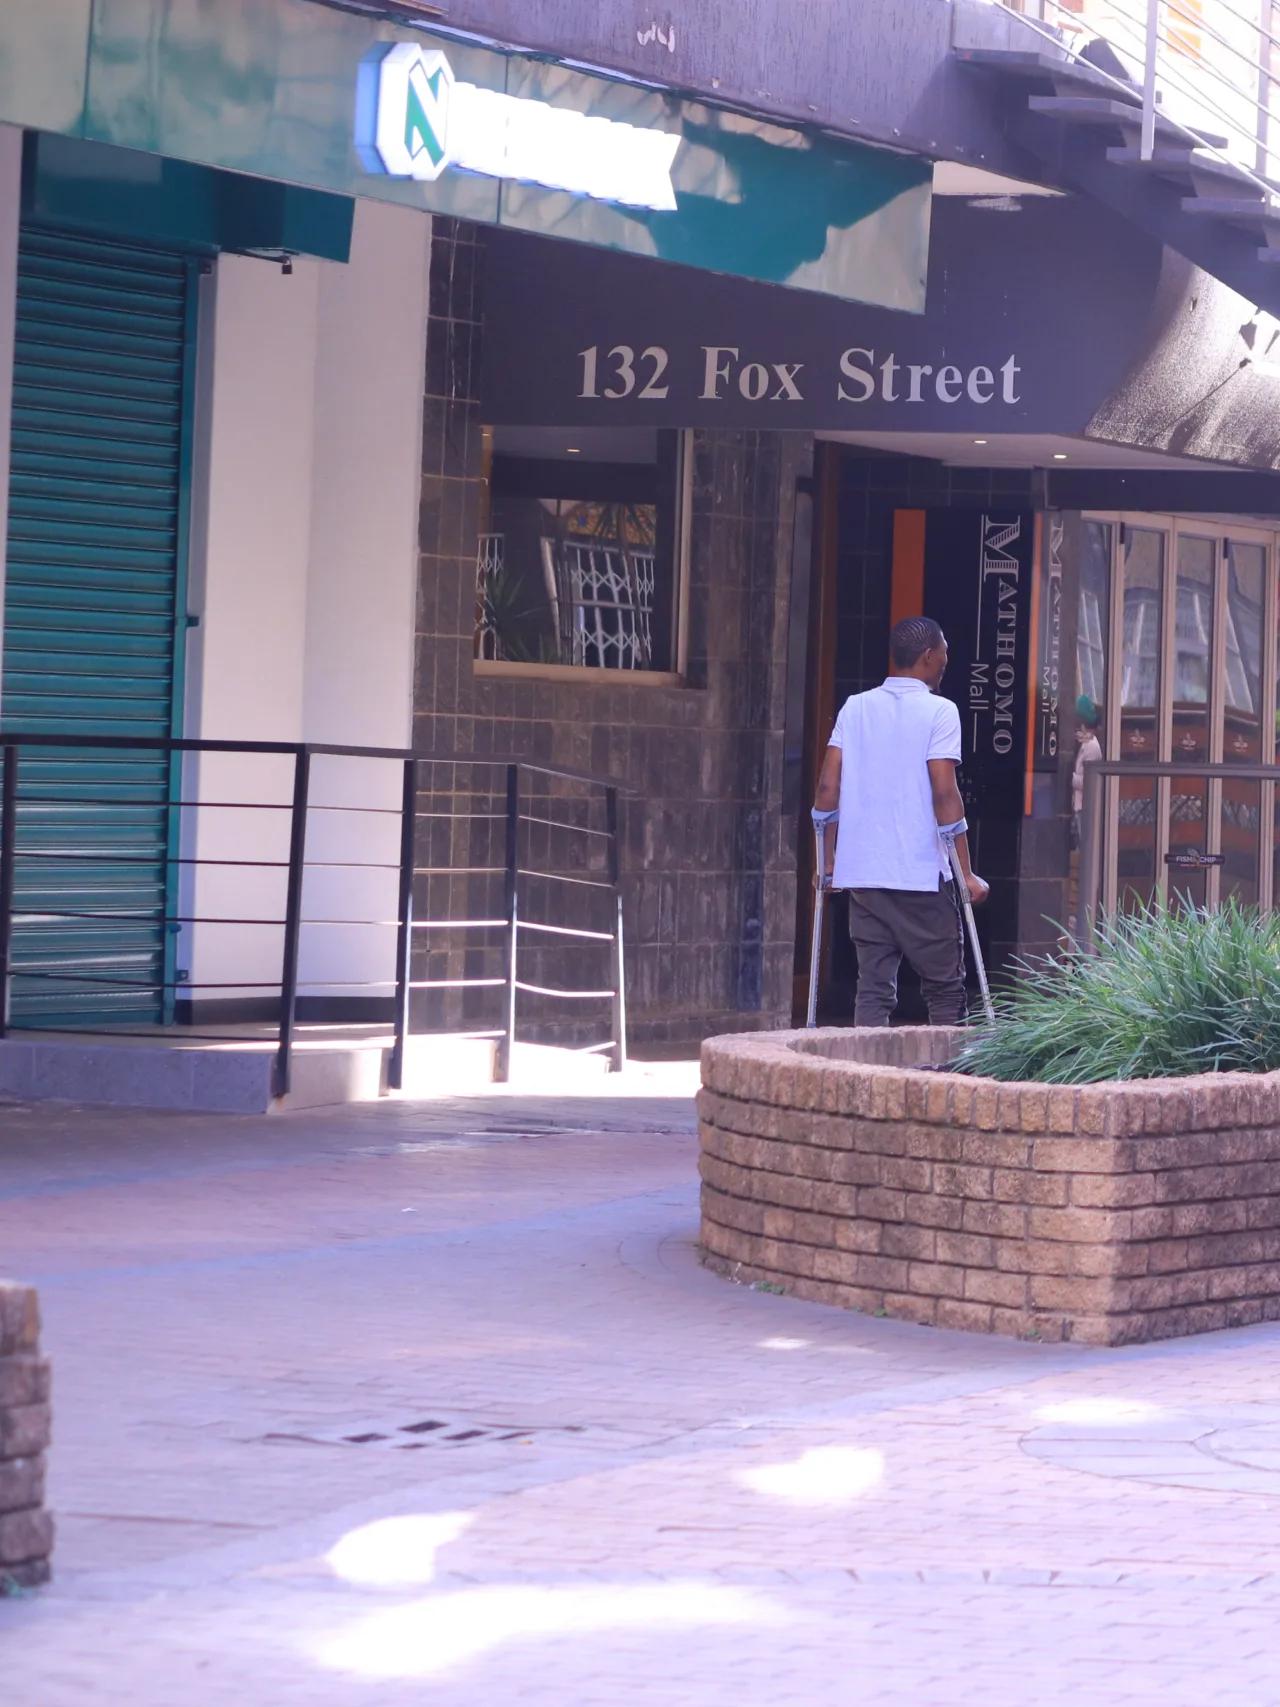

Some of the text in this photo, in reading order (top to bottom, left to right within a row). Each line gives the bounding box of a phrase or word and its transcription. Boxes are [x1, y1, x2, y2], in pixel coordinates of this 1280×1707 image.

[576, 345, 1022, 404] 132 Fox Street
[984, 515, 1020, 754] MATHOMO
[970, 663, 990, 710] Mall
[1042, 667, 1051, 712] Mall
